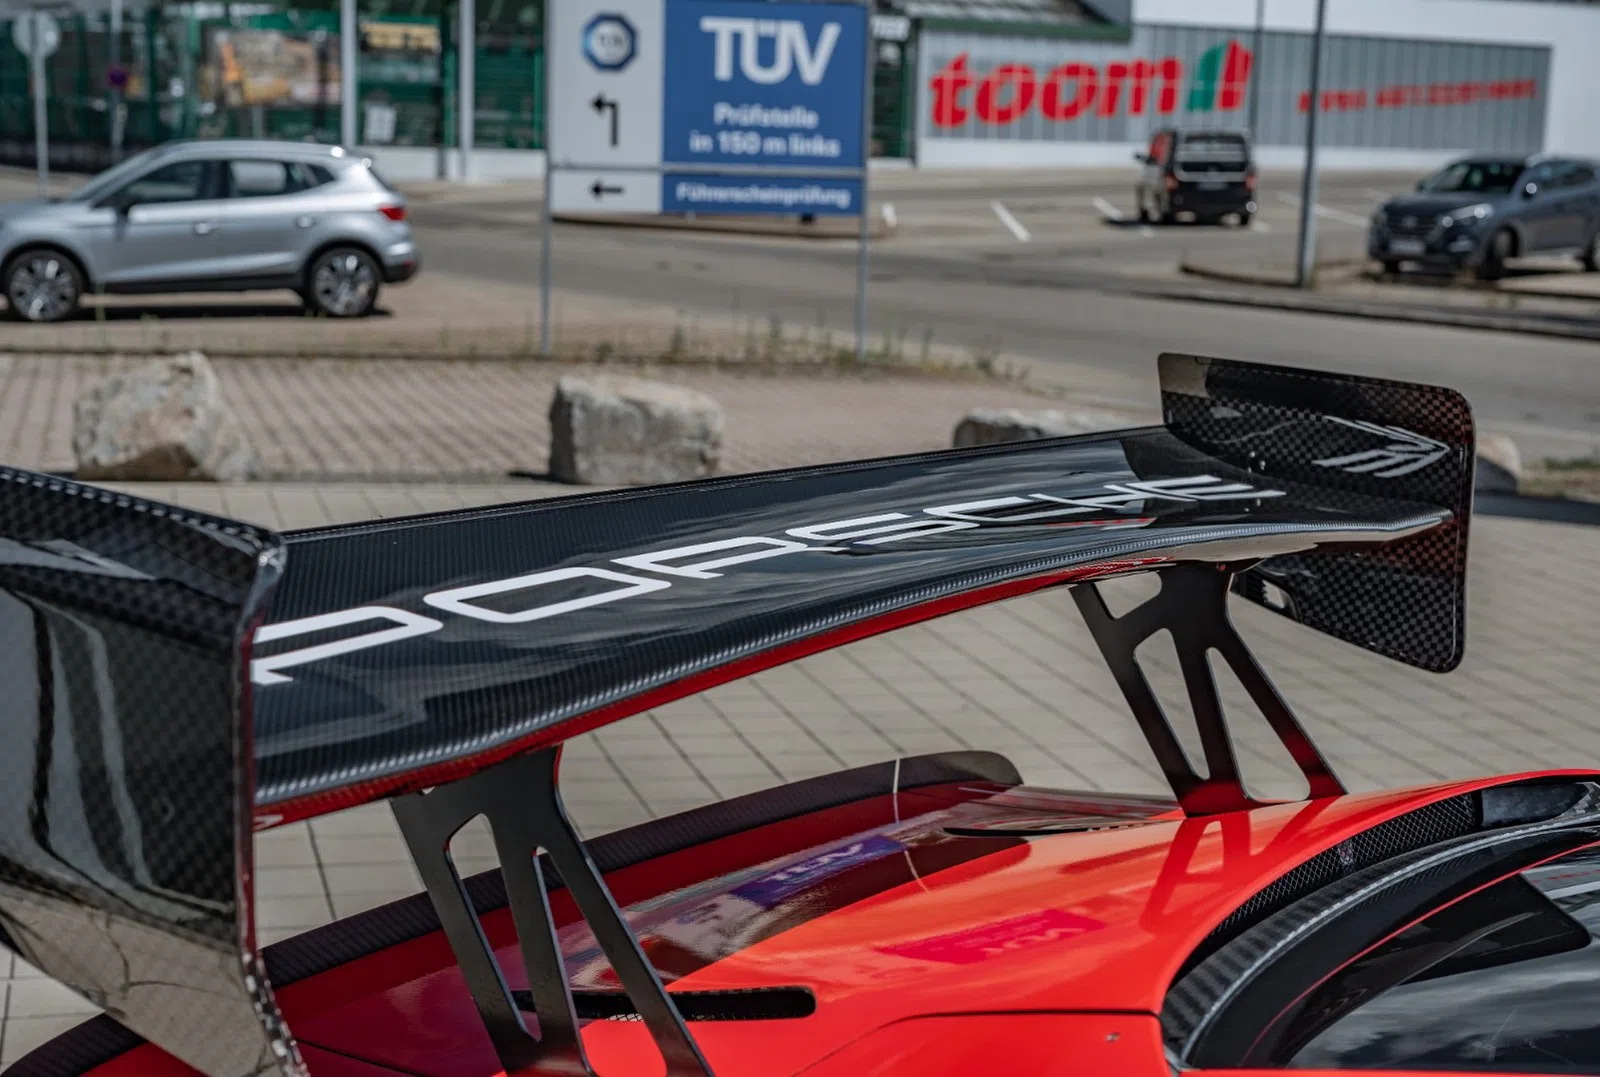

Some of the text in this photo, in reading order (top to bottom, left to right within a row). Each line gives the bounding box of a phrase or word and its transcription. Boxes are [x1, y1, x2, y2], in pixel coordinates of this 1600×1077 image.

[700, 16, 841, 84] TÜV
[930, 52, 1182, 127] toom
[714, 102, 819, 129] Prüfstelle
[689, 130, 841, 157] in 150 m links
